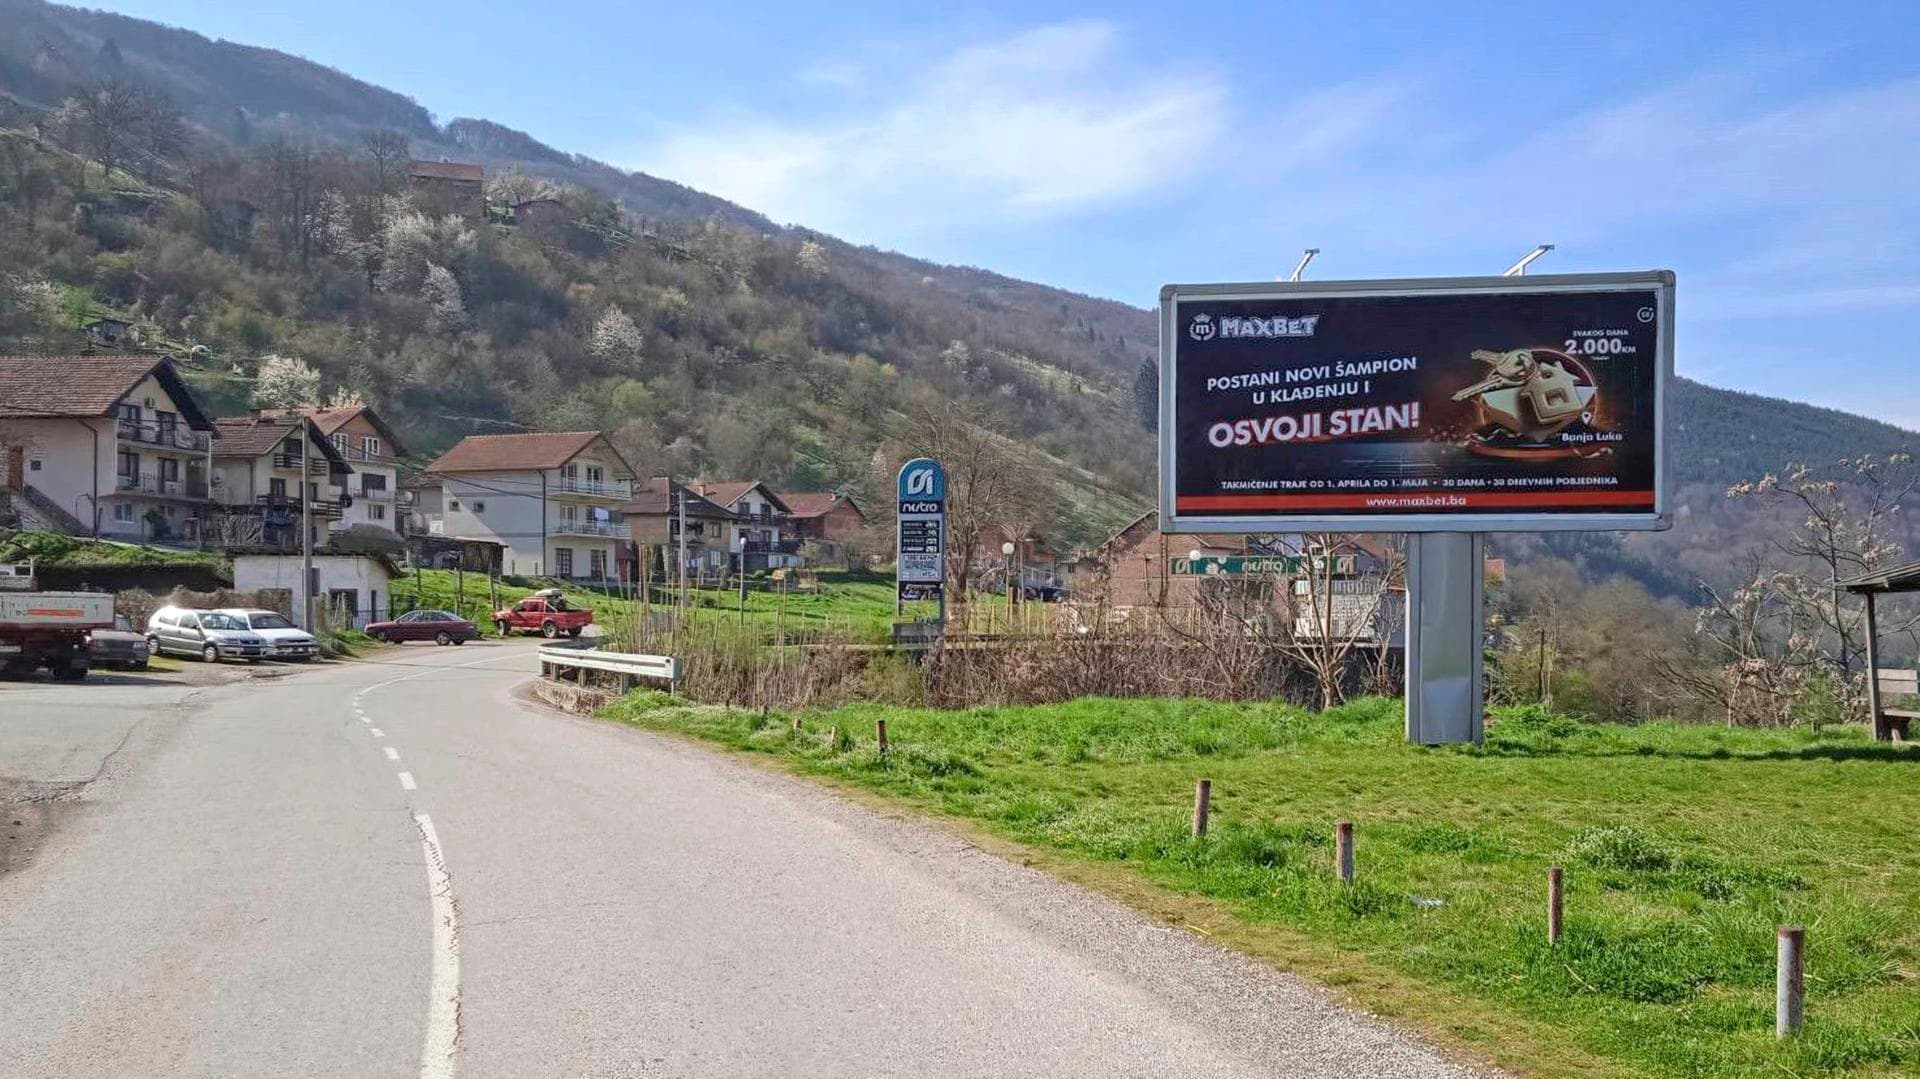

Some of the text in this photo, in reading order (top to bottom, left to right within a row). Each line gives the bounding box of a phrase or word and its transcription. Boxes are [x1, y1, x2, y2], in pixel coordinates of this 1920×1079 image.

[1207, 356, 1417, 391] POSTANI NOVI ŠAMPION
[1253, 381, 1370, 404] U KLAĐENJU I
[1208, 401, 1419, 448] OSVOJI STAN!
[1562, 431, 1623, 443] Banja Luka
[1280, 480, 1307, 489] TRAJE
[1309, 480, 1325, 488] OD
[1327, 480, 1335, 488] 1.
[1338, 479, 1371, 488] APRILA
[1374, 479, 1388, 487] DO
[1401, 479, 1428, 487] MAJA
[1457, 479, 1486, 487] DANA
[1507, 478, 1554, 486] DNEVNIH
[1556, 477, 1618, 485] POBJEDNIKA
[1366, 494, 1467, 507] www.maxbet.ba
